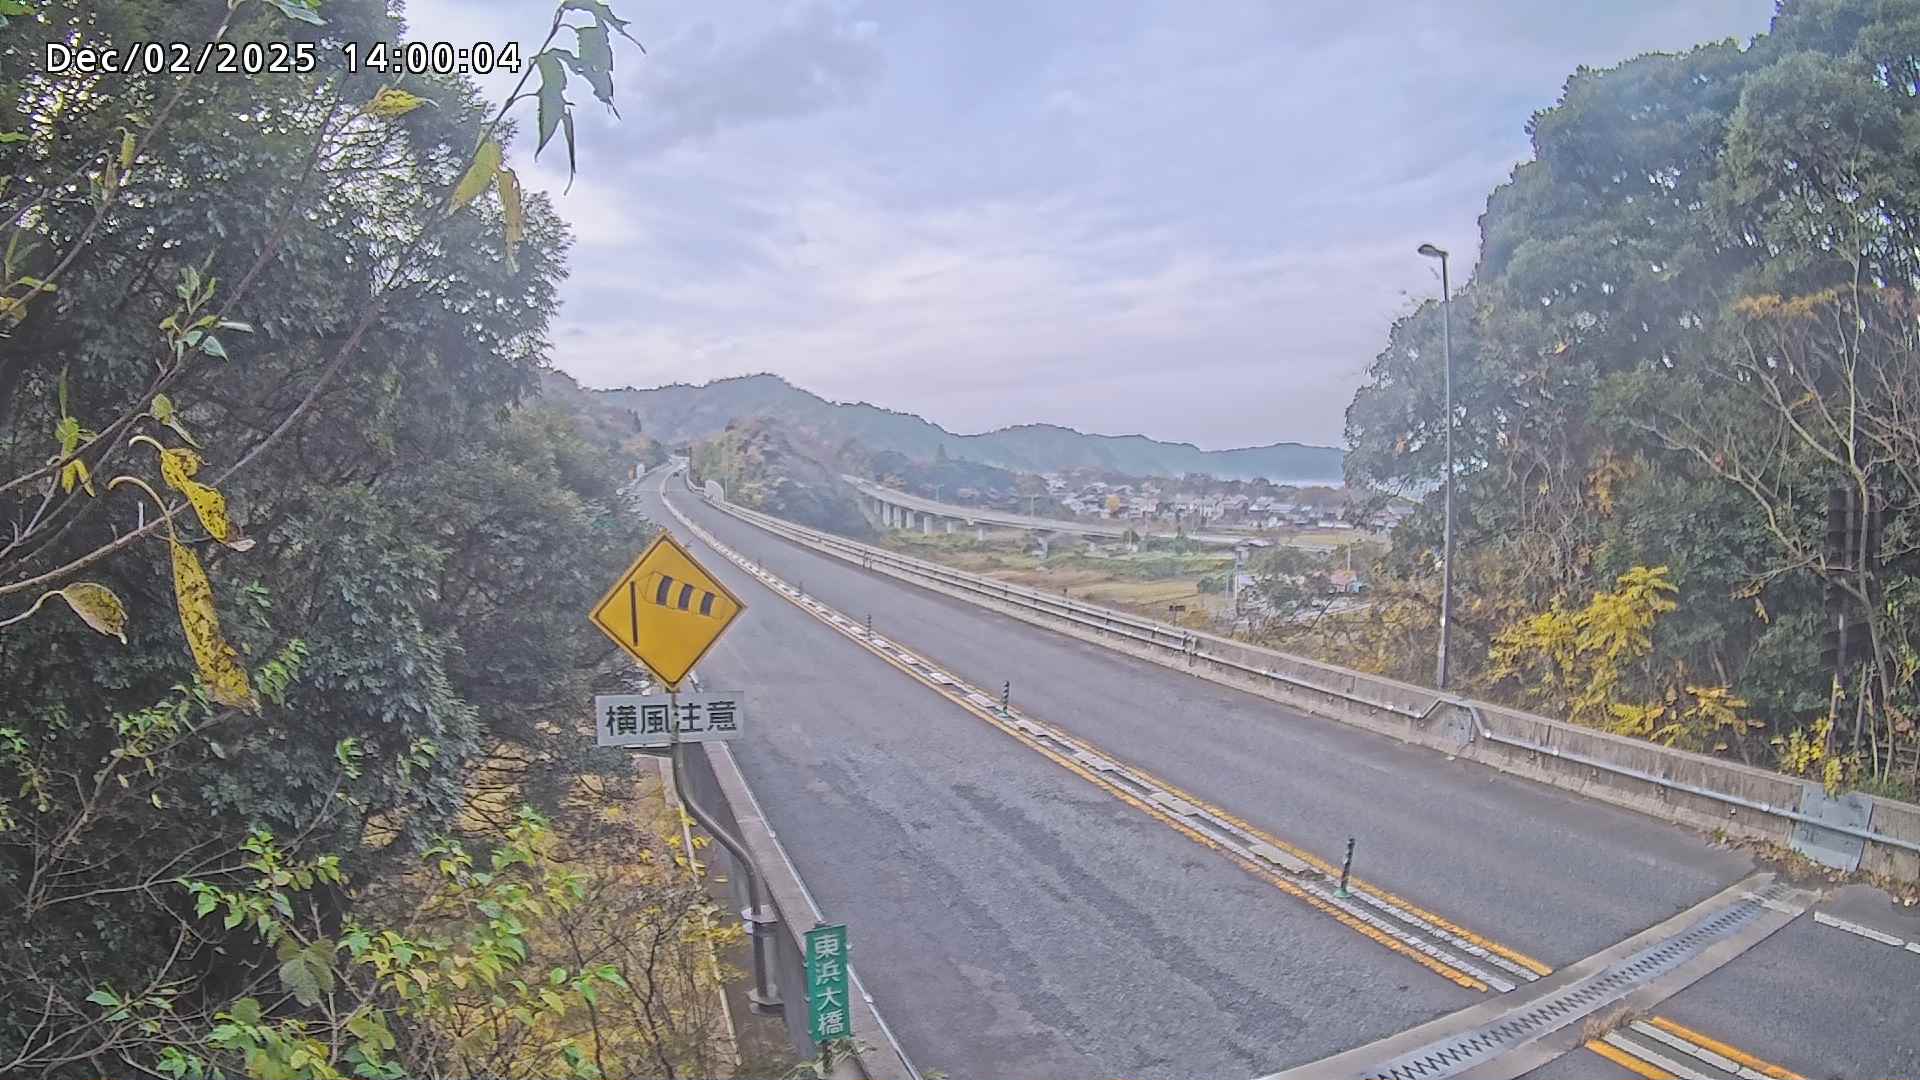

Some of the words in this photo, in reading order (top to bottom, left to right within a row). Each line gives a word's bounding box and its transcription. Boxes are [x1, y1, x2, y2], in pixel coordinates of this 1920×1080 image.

[606, 701, 737, 736] 横風注意
[814, 933, 844, 1036] 東浜大橋
